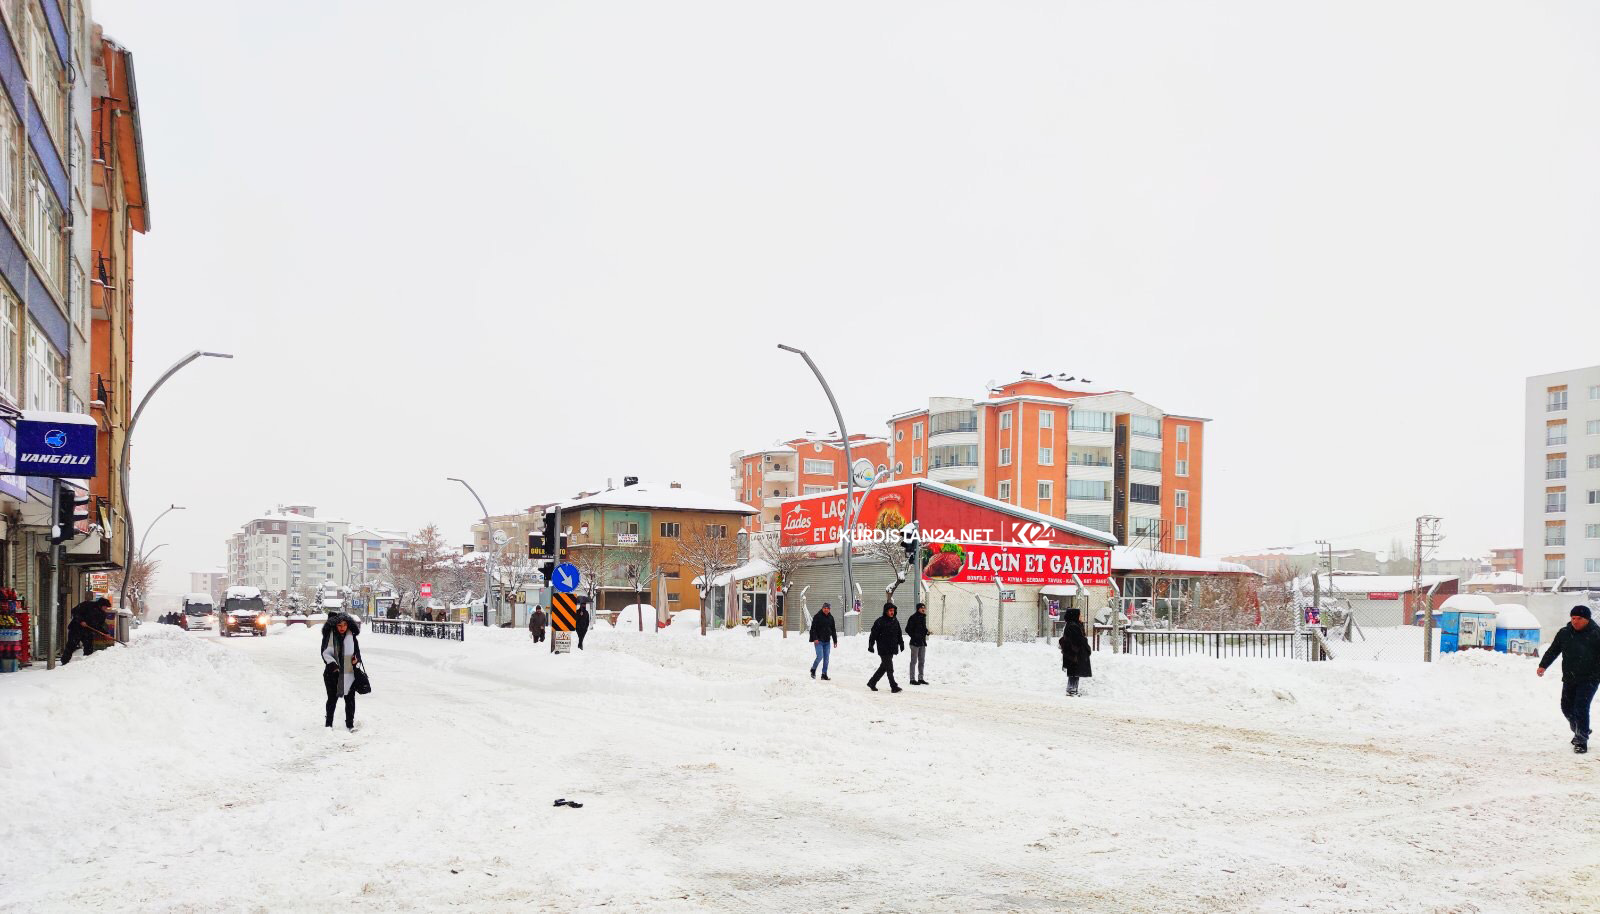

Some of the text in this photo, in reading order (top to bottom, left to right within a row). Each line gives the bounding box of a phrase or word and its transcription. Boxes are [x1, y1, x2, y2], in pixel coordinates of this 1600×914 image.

[20, 453, 91, 465] VANGÖLÜ
[821, 496, 861, 521] LAÇN
[784, 513, 811, 530] Lades
[813, 527, 827, 542] ET
[967, 549, 1110, 575] LAÇİN ET GALERİ
